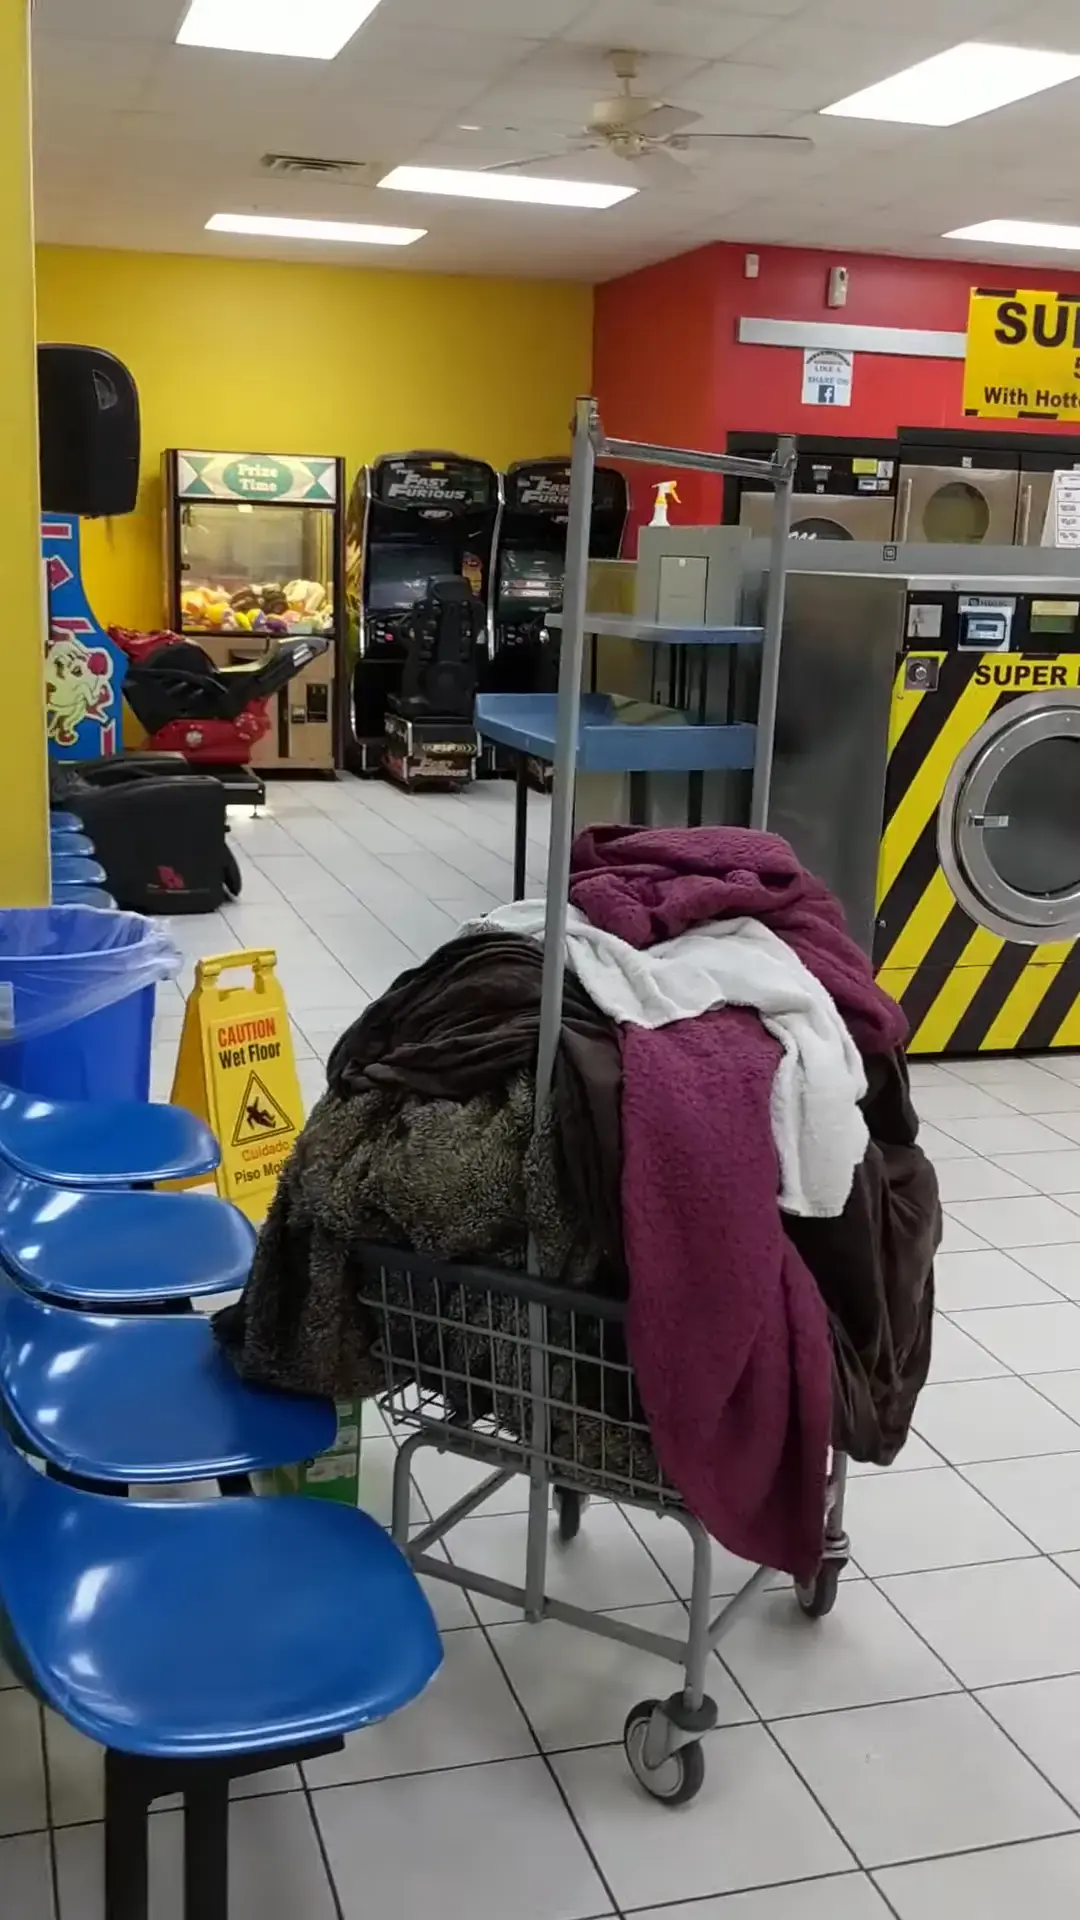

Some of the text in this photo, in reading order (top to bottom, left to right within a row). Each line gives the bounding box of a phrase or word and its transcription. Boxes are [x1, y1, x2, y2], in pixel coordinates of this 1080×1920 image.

[984, 386, 1028, 405] With
[237, 463, 279, 478] Prize
[239, 478, 277, 492] Time
[403, 473, 449, 487] FAST
[536, 480, 570, 494] FAS
[388, 483, 467, 500] FURIOUS
[521, 489, 570, 504] FURI
[975, 665, 1067, 686] SUPER
[217, 1017, 276, 1048] CAUTION
[218, 1042, 281, 1069] Wet Floor
[242, 1140, 290, 1161] Cuidado
[234, 1160, 284, 1185] Piso Mo
